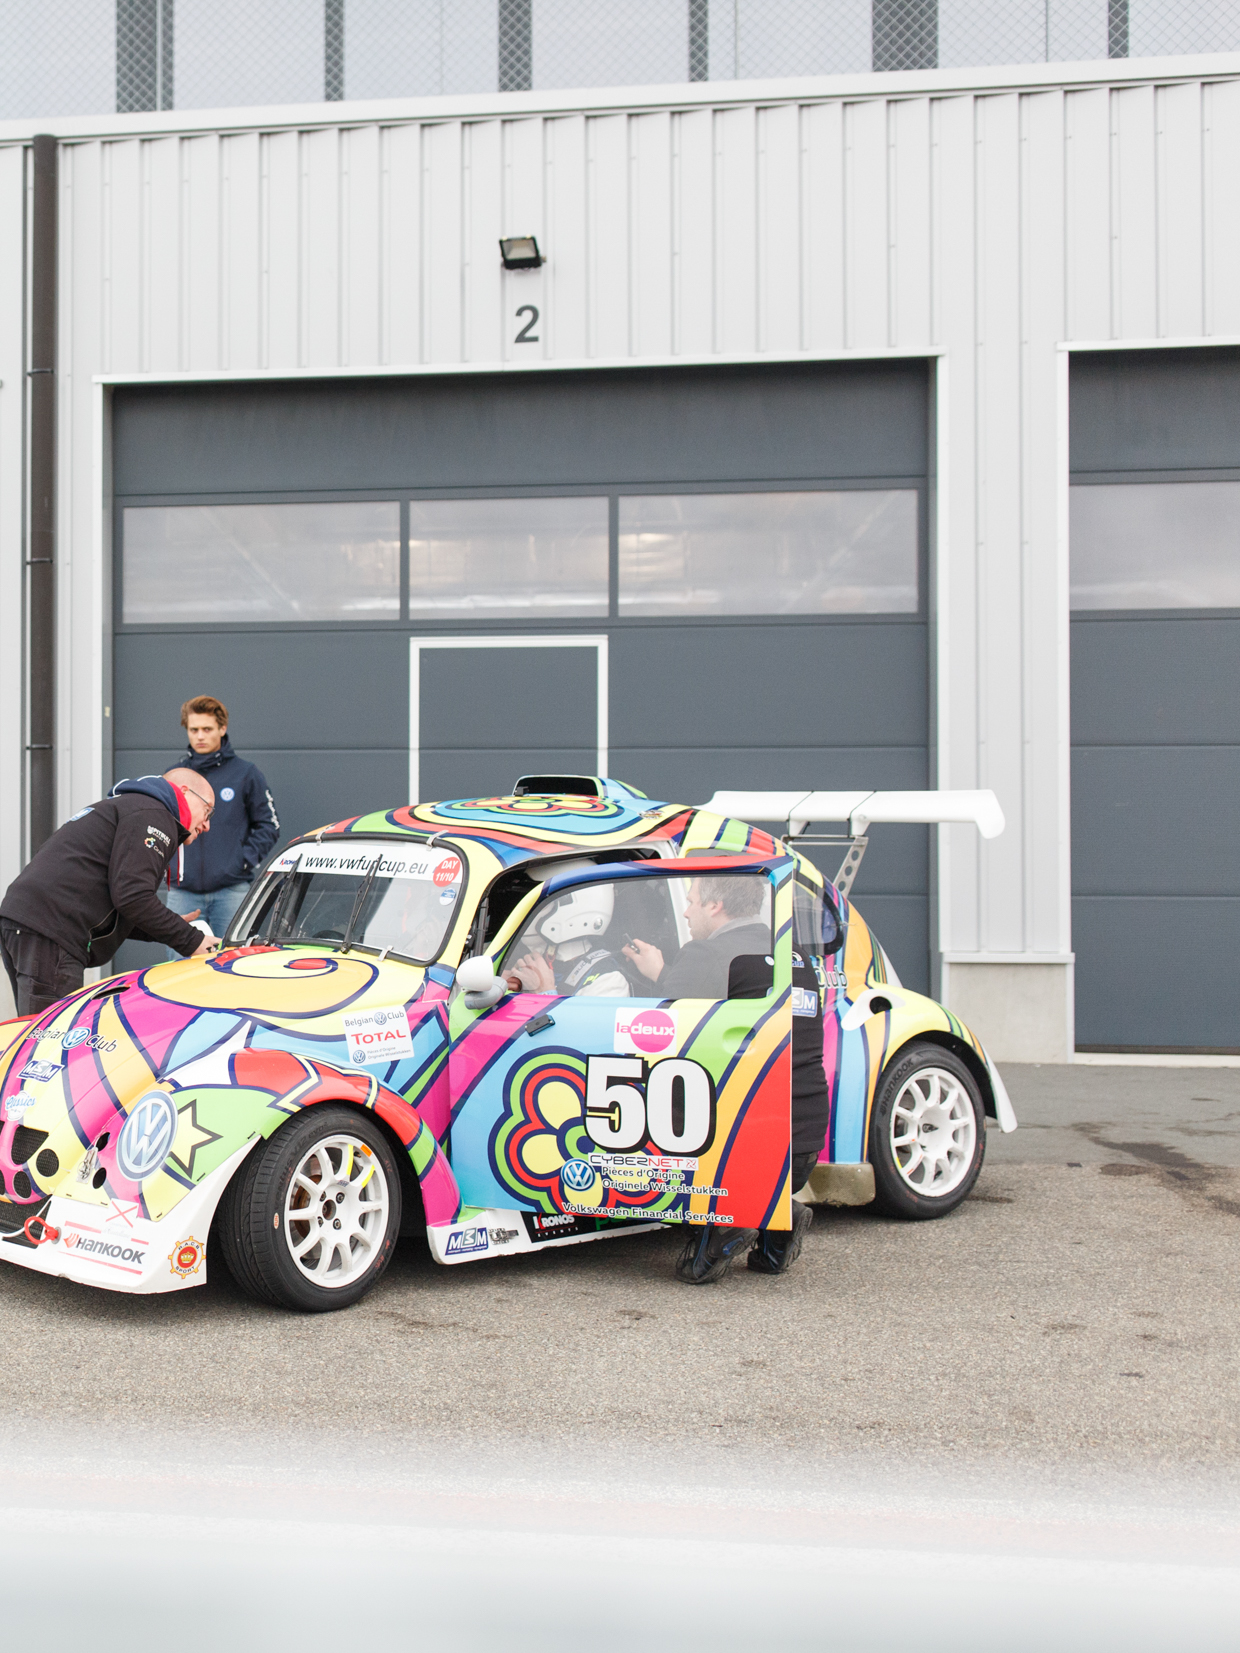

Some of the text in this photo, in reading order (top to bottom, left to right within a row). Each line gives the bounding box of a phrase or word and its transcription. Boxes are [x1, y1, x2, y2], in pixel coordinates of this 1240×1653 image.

[514, 305, 541, 344] 2
[441, 860, 458, 870] DAY
[435, 872, 454, 882] 11/10
[344, 1017, 374, 1027] Belgian
[387, 1011, 405, 1020] Club
[350, 1029, 407, 1045] TOTAL
[616, 1022, 675, 1036] ladeux
[85, 1033, 118, 1053] Club
[583, 1054, 717, 1157] 50
[589, 1154, 684, 1168] CYBERNET
[602, 1166, 634, 1177] Pièces
[602, 1179, 728, 1197] Originele Wisselstukken
[562, 1201, 734, 1224] Volkswagen Financial Services
[532, 1212, 575, 1230] KRONOS
